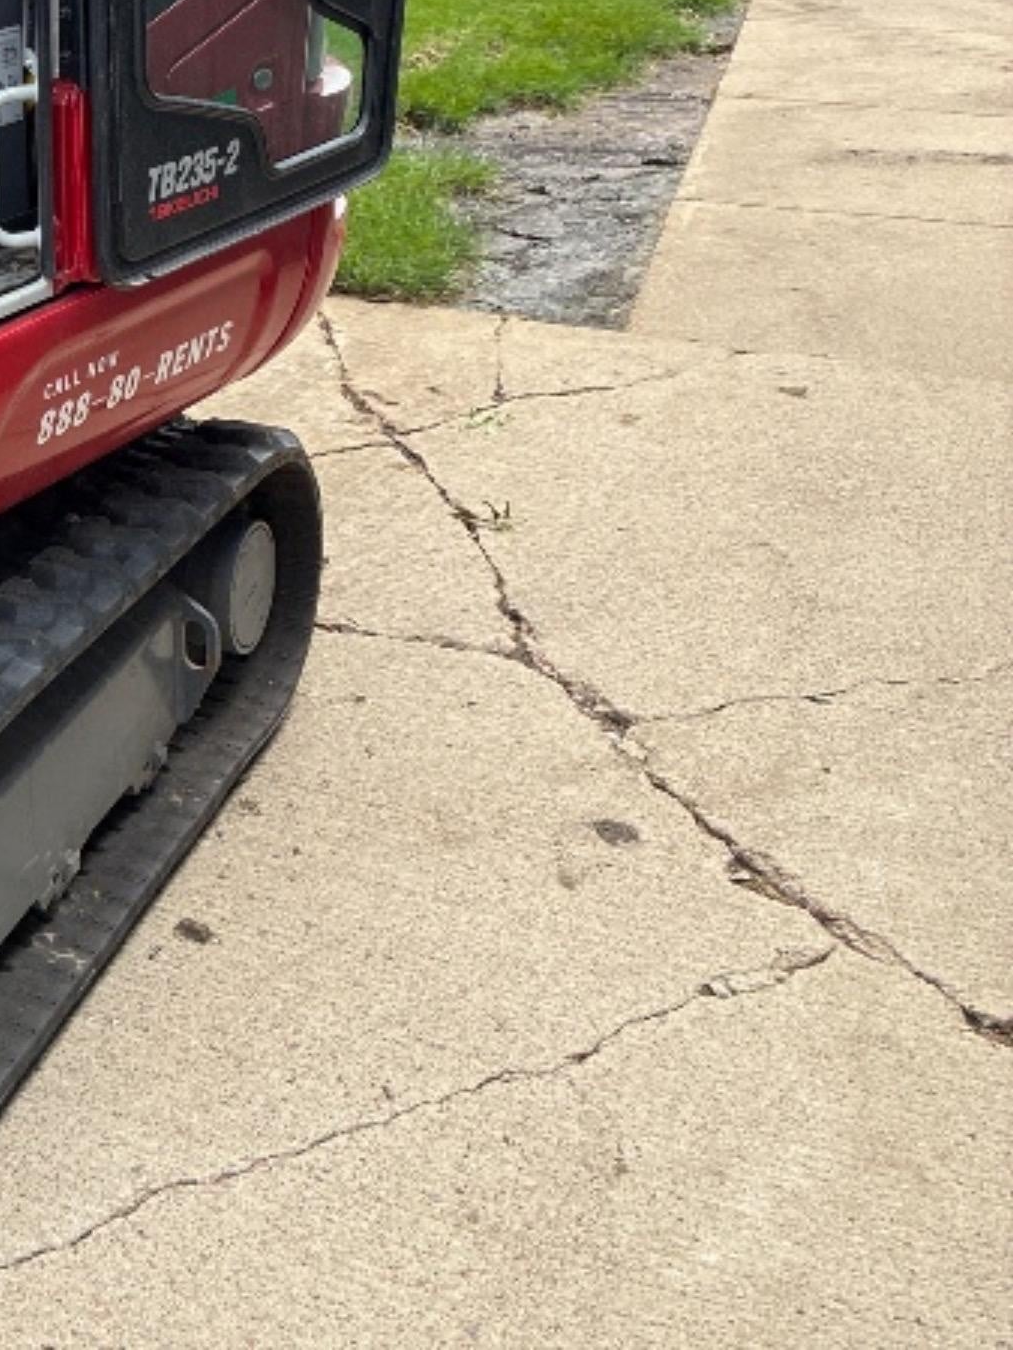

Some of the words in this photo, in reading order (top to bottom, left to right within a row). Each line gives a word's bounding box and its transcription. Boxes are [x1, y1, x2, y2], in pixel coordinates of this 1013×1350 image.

[149, 139, 240, 203] TB235-2
[37, 320, 234, 446] 888-80-RENTS
[43, 370, 81, 400] CALL
[86, 350, 120, 378] NOW
